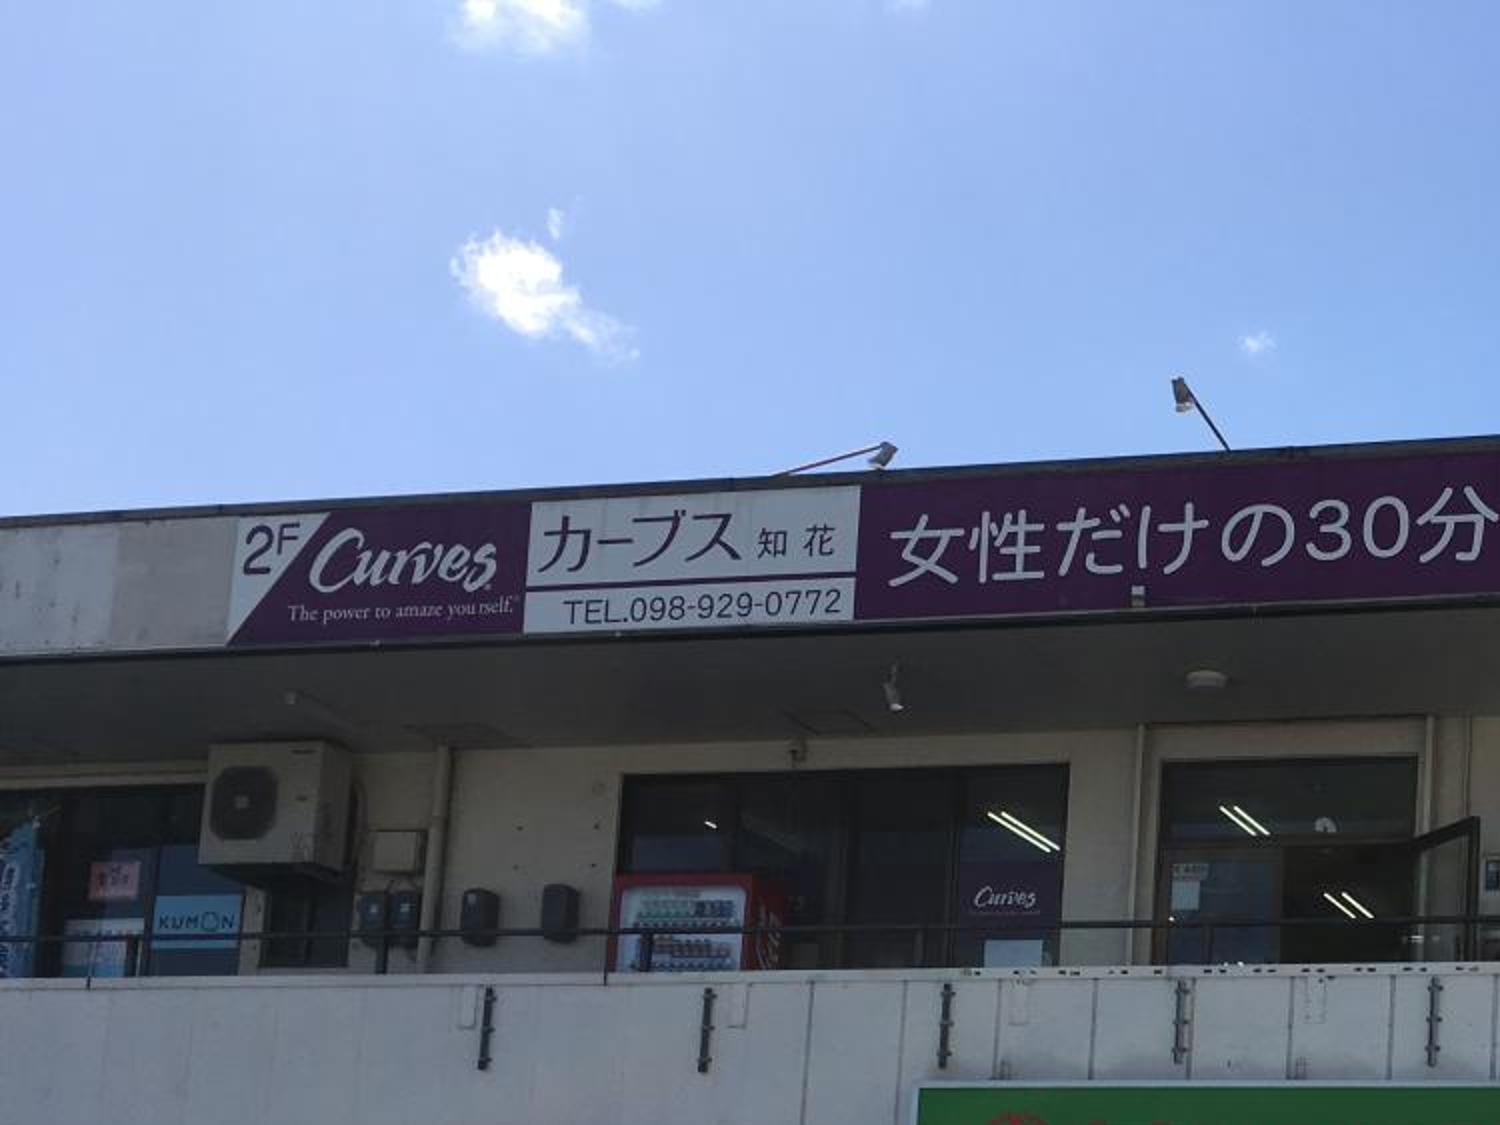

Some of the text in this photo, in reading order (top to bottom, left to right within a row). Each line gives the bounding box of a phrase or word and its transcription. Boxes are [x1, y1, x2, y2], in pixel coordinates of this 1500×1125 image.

[242, 522, 300, 575] 2F
[309, 527, 497, 593] Curves
[537, 508, 836, 573] カーブス 知花
[287, 604, 318, 623] The
[322, 606, 371, 625] power
[375, 605, 391, 619] to
[395, 604, 443, 618] amaze
[563, 588, 841, 626] TEL.098-929-0772
[158, 912, 235, 932] KUMON
